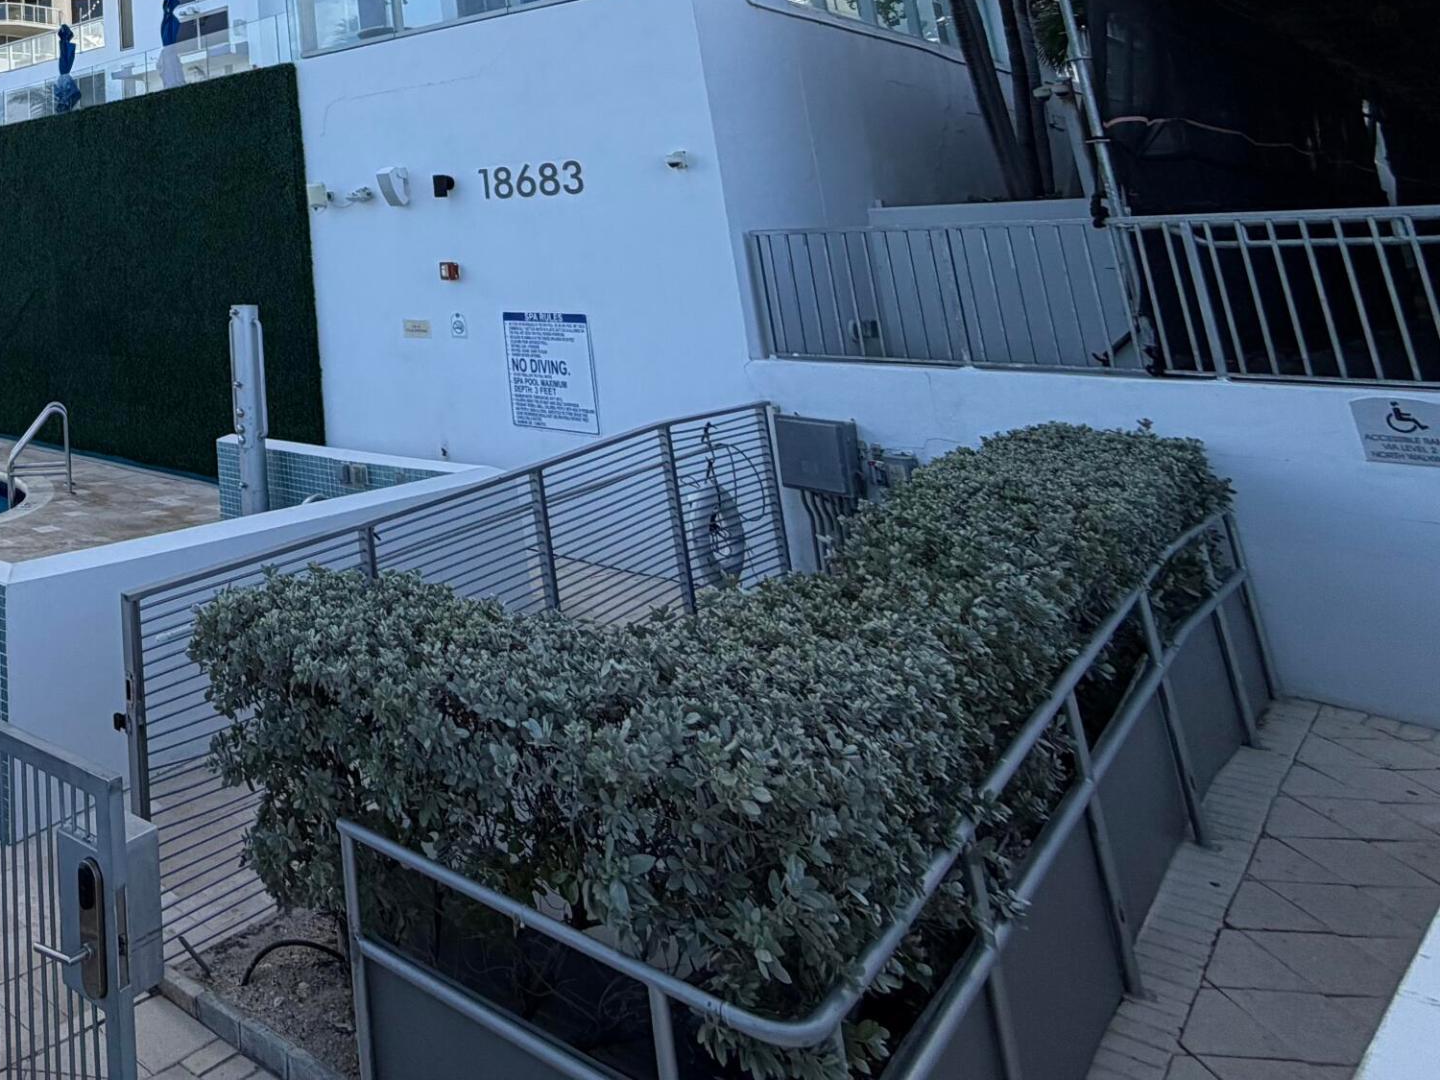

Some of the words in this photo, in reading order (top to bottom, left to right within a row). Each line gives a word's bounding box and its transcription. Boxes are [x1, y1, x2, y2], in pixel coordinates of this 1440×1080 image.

[478, 160, 584, 199] 18683
[539, 312, 563, 322] RULES
[511, 358, 527, 373] NO
[530, 359, 571, 376] DIVING.
[513, 377, 523, 385] SPA
[524, 378, 539, 387] POOL
[540, 379, 568, 389] MAXIMUM
[539, 387, 557, 396] FEET
